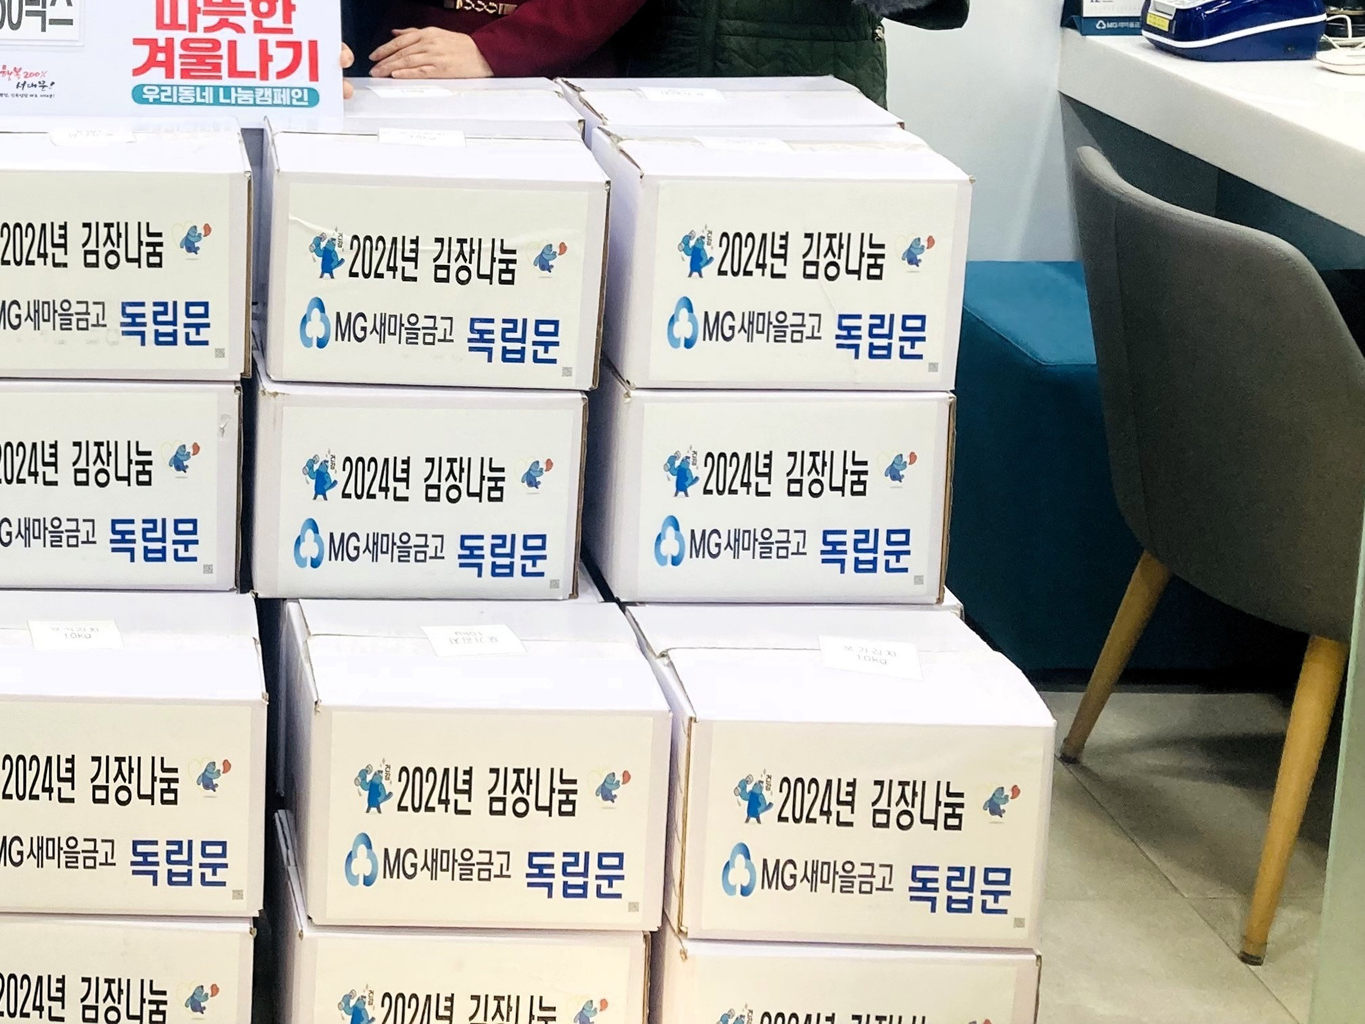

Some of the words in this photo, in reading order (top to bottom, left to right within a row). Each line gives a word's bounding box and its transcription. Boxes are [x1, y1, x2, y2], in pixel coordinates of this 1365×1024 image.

[132, 38, 319, 82] 겨울나기
[142, 86, 213, 104] 우리동네
[219, 87, 309, 106] 나눔캠페인
[0, 221, 68, 268] 2024년
[82, 221, 163, 270] 김장나눔
[349, 235, 419, 282] 2024년
[433, 237, 517, 285] 김장나눔
[717, 231, 789, 279] 2024년
[802, 232, 885, 281] 김장나눔
[120, 301, 210, 346] 독립문
[467, 318, 559, 364] 독립문
[835, 314, 926, 360] 독립문
[72, 440, 153, 488] 김장나눔
[342, 456, 410, 502] 2024년
[424, 456, 505, 504] 김장나눔
[703, 450, 772, 497] 2024년
[786, 450, 868, 498] 김장나눔
[110, 518, 199, 562] 독립문
[458, 534, 547, 578] 독립문
[820, 528, 911, 574] 독립문
[2, 754, 75, 803] 2024년
[90, 755, 179, 806] 김장나눔
[397, 766, 473, 815] 2024년
[488, 767, 578, 818] 김장나눔
[778, 777, 856, 827] 2024년
[872, 779, 964, 831] 김장나눔
[130, 840, 228, 886] 독립문
[526, 851, 624, 898] 독립문
[909, 865, 1011, 914] 독립문
[80, 977, 167, 1024] 김장나눔
